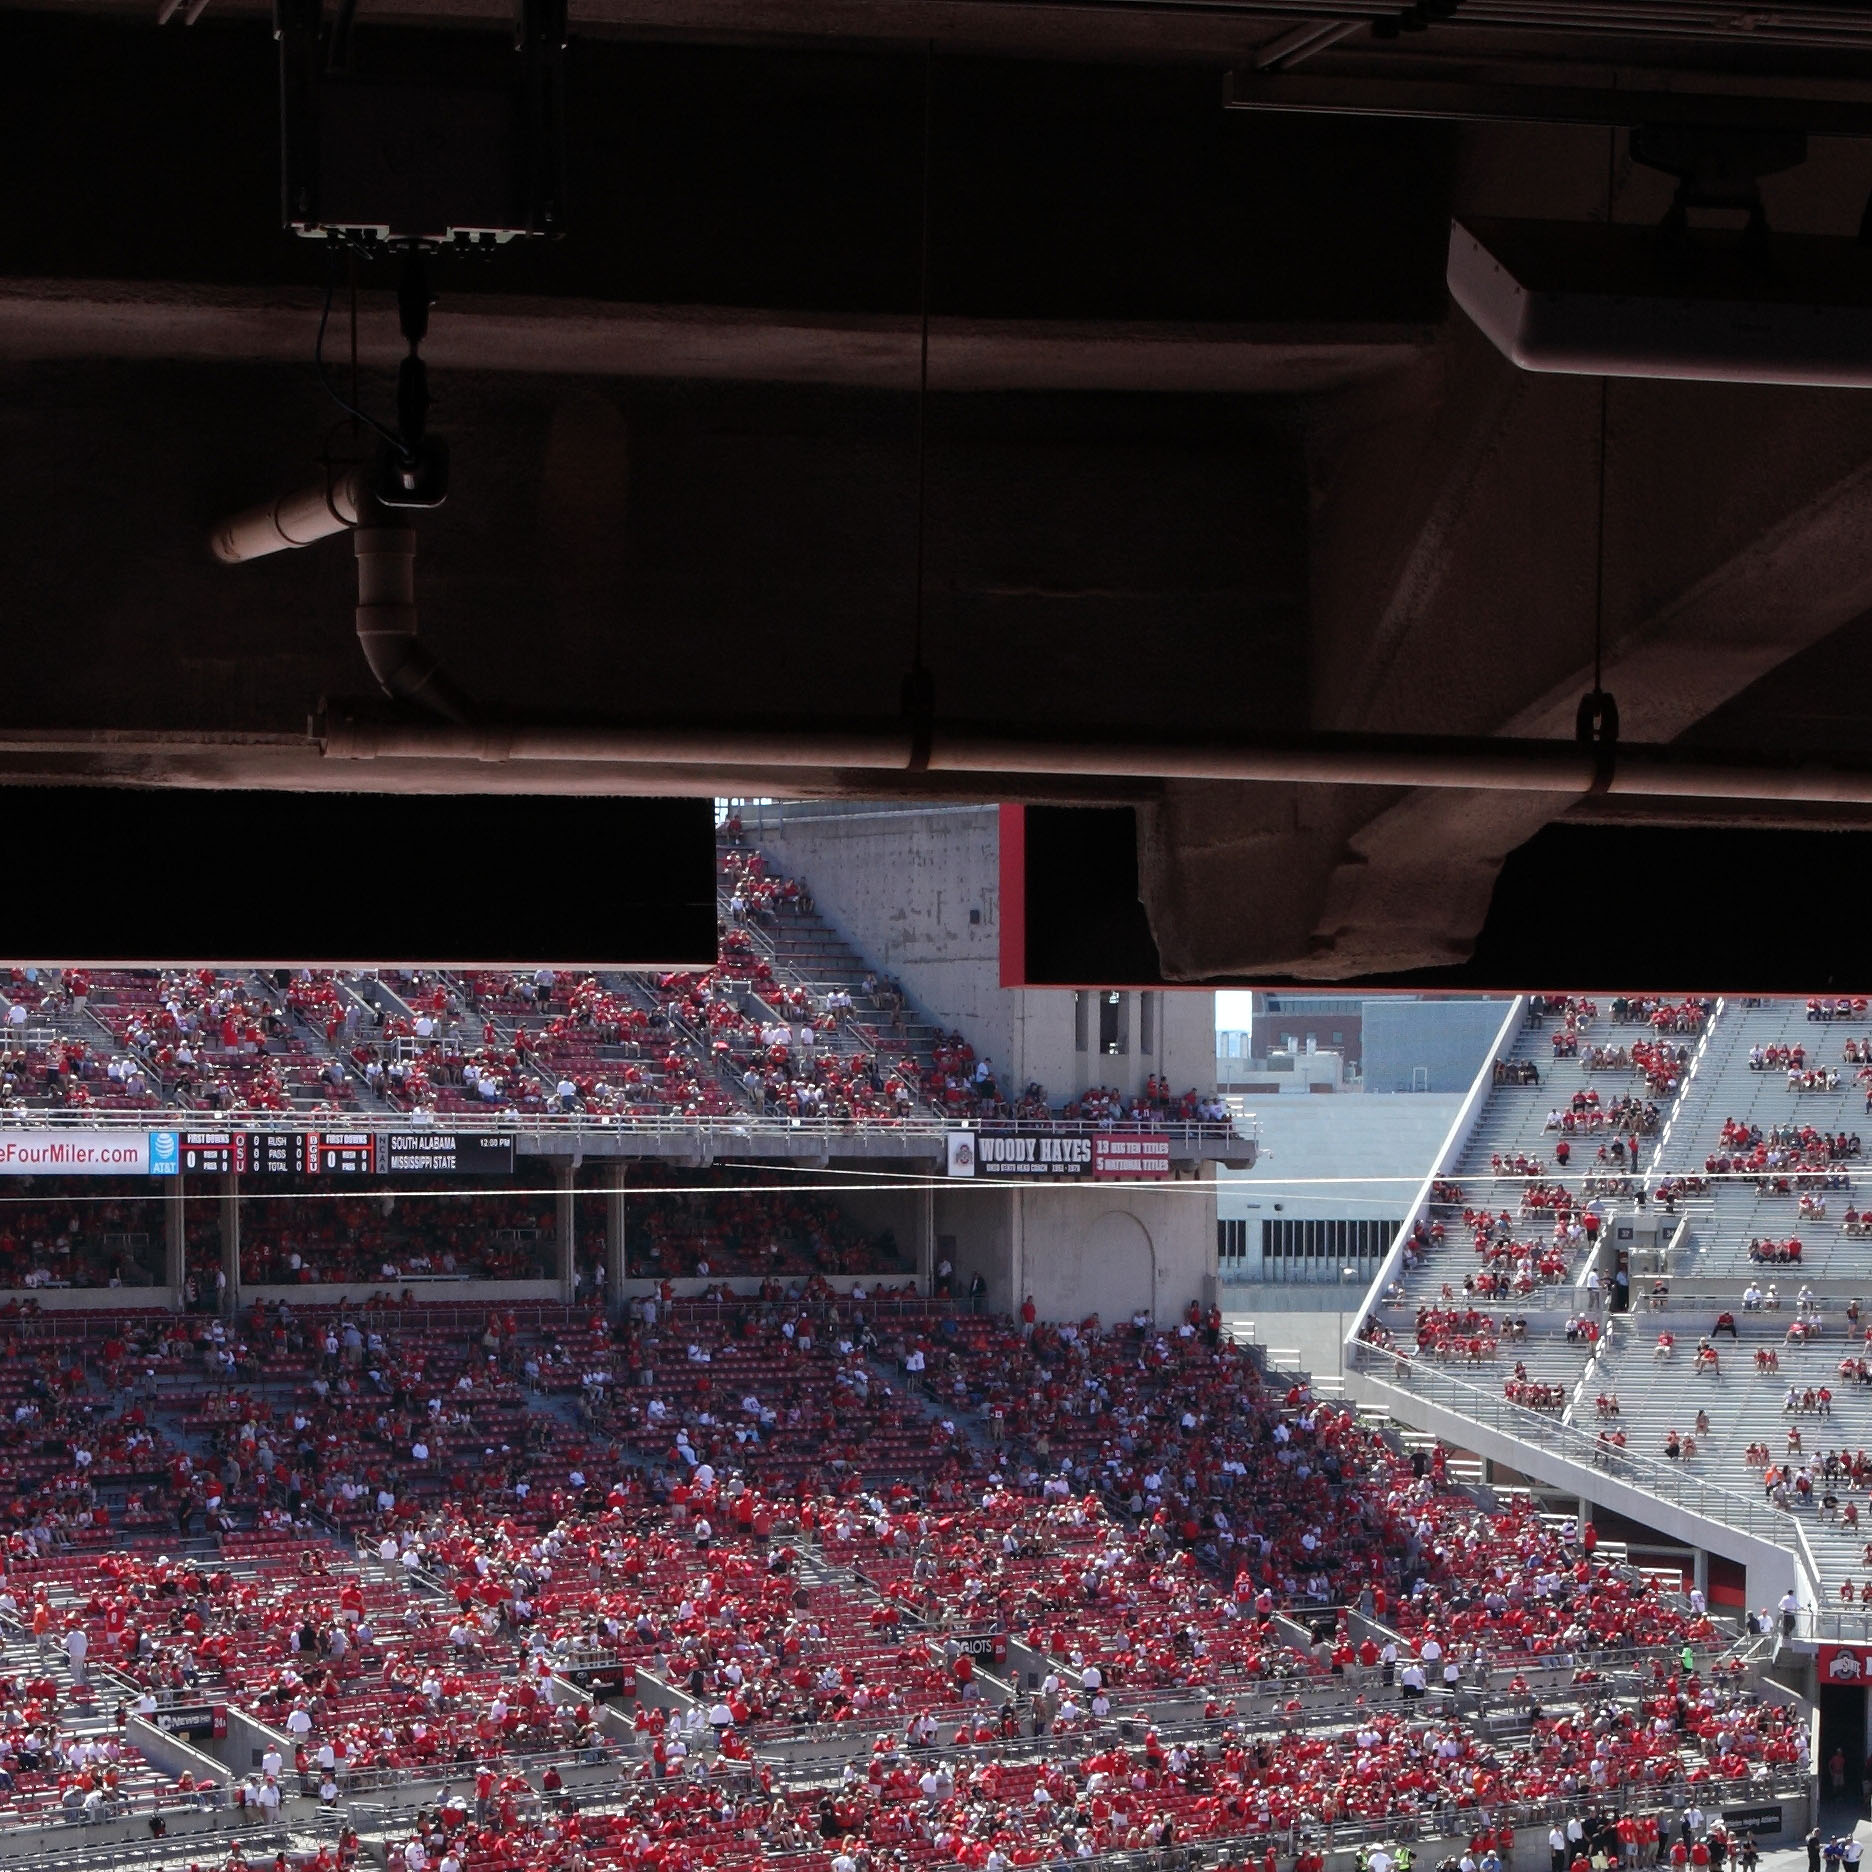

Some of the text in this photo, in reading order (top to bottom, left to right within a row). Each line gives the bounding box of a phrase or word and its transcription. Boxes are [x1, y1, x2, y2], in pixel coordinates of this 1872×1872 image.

[186, 1133, 206, 1145] FIRST
[326, 1134, 344, 1145] FIRST
[391, 1136, 419, 1151] SOUTH
[418, 1136, 457, 1151] ALABAMA
[499, 1138, 511, 1148] PM
[268, 1149, 287, 1160] PASS
[978, 1137, 1092, 1163] WOODY HAYES
[1142, 1141, 1169, 1156] TITLES
[186, 1150, 196, 1169] 0
[267, 1161, 289, 1172] TOTAL
[327, 1150, 336, 1169] 0
[391, 1155, 457, 1170] MISSISSIPPI STATE
[1095, 1157, 1105, 1171] 5
[1142, 1158, 1169, 1172] TITLES
[153, 1161, 177, 1175] AT&T
[969, 1639, 992, 1655] LOTS
[171, 1715, 200, 1730] NEWS
